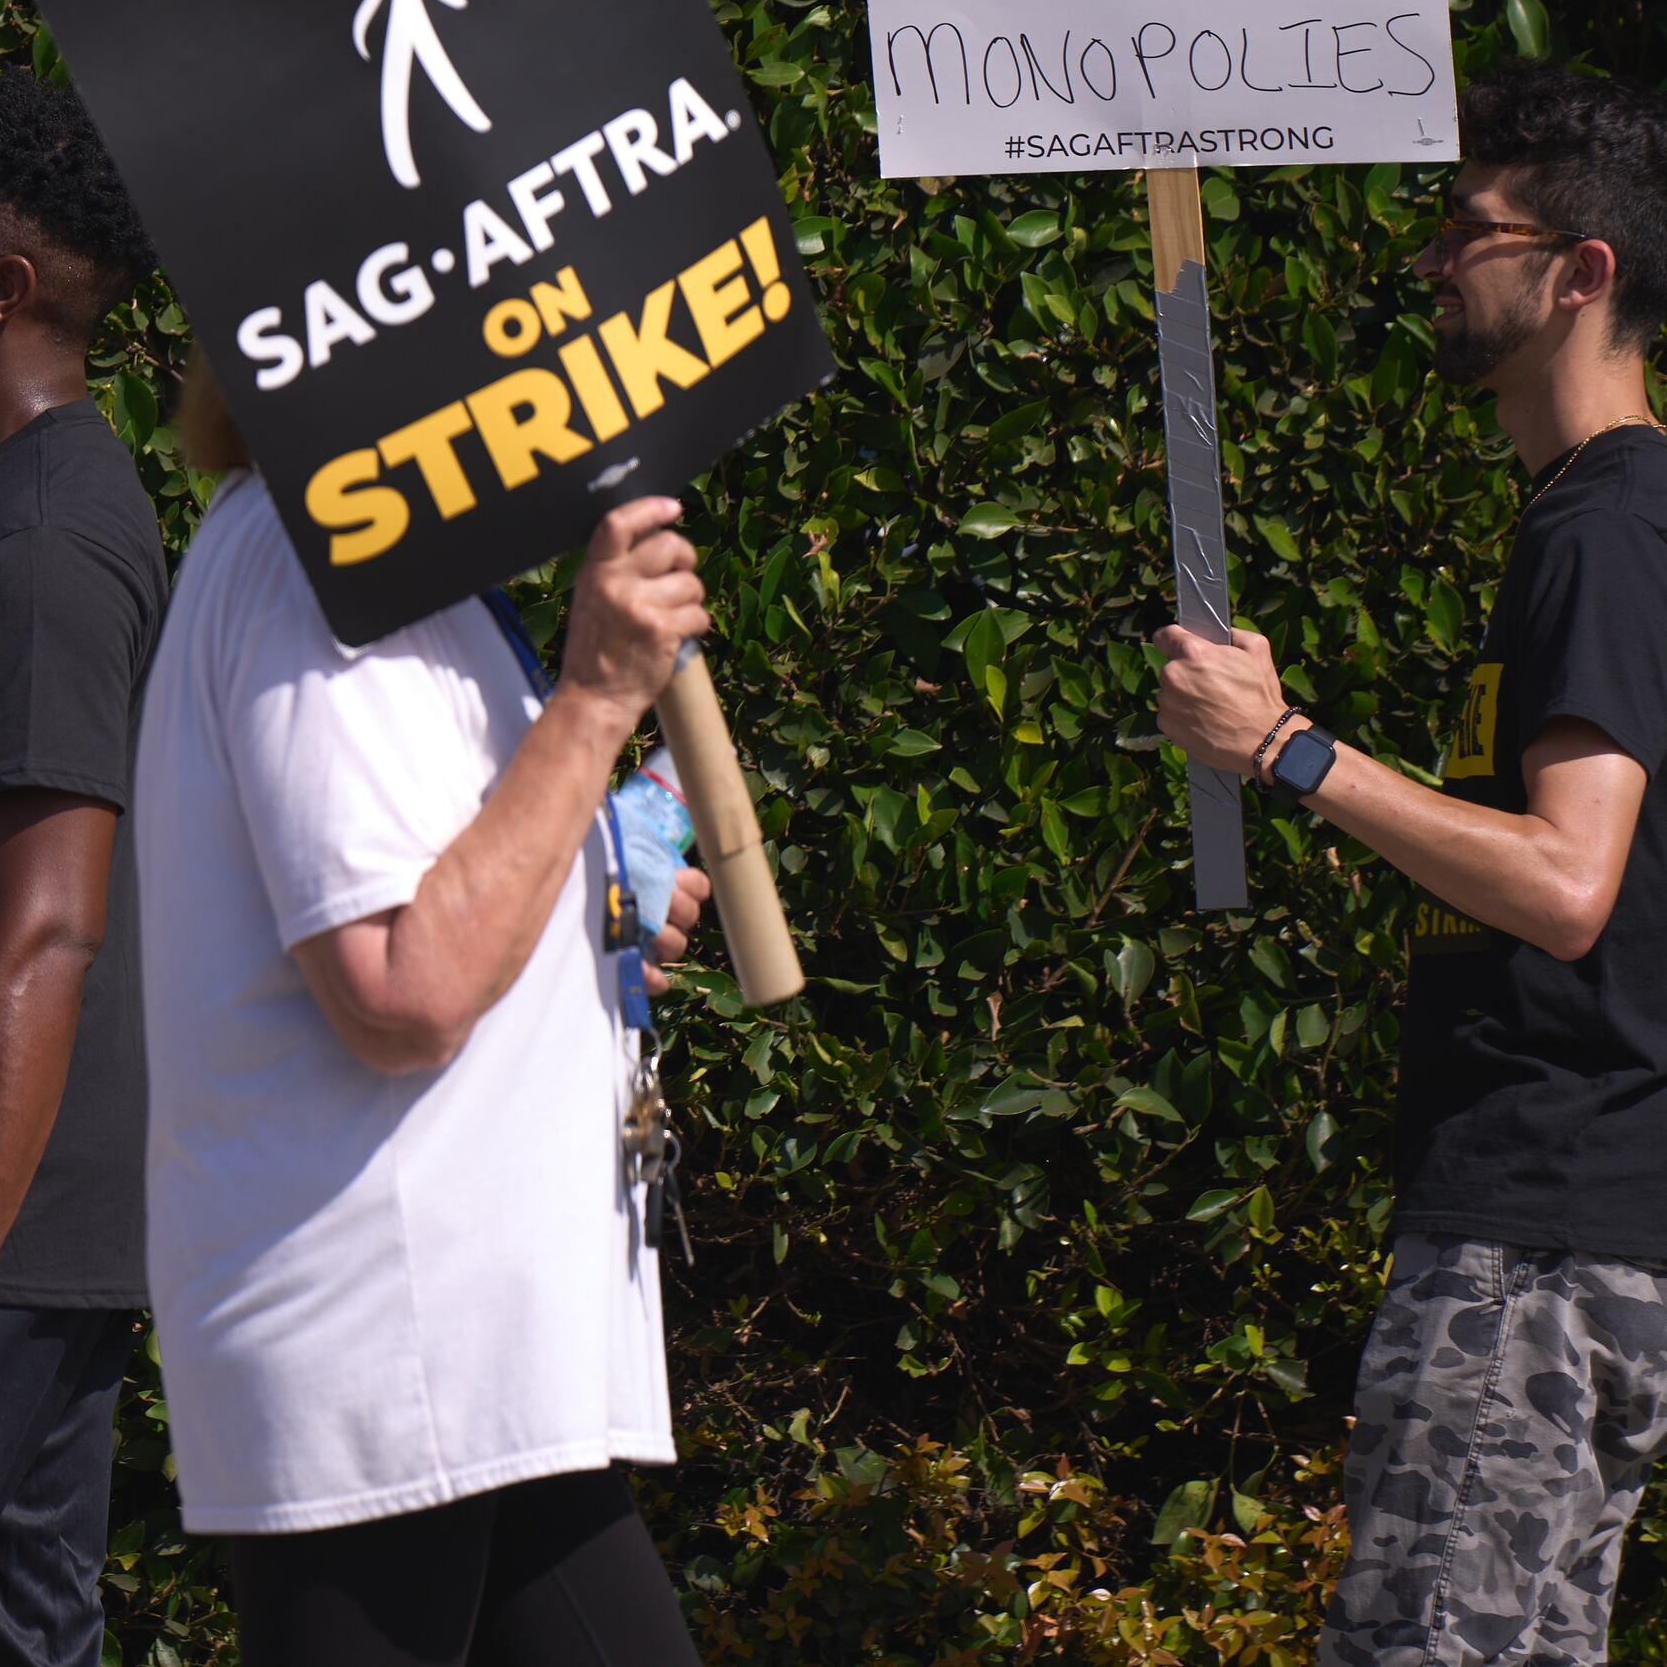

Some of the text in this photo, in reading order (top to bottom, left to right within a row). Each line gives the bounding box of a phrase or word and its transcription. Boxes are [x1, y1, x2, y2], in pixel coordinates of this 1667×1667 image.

[887, 13, 1435, 109] MONOPOLIES
[1004, 126, 1334, 159] #SAGAFTRASTRONG
[483, 267, 592, 358] ON
[304, 216, 792, 566] STRIKE!
